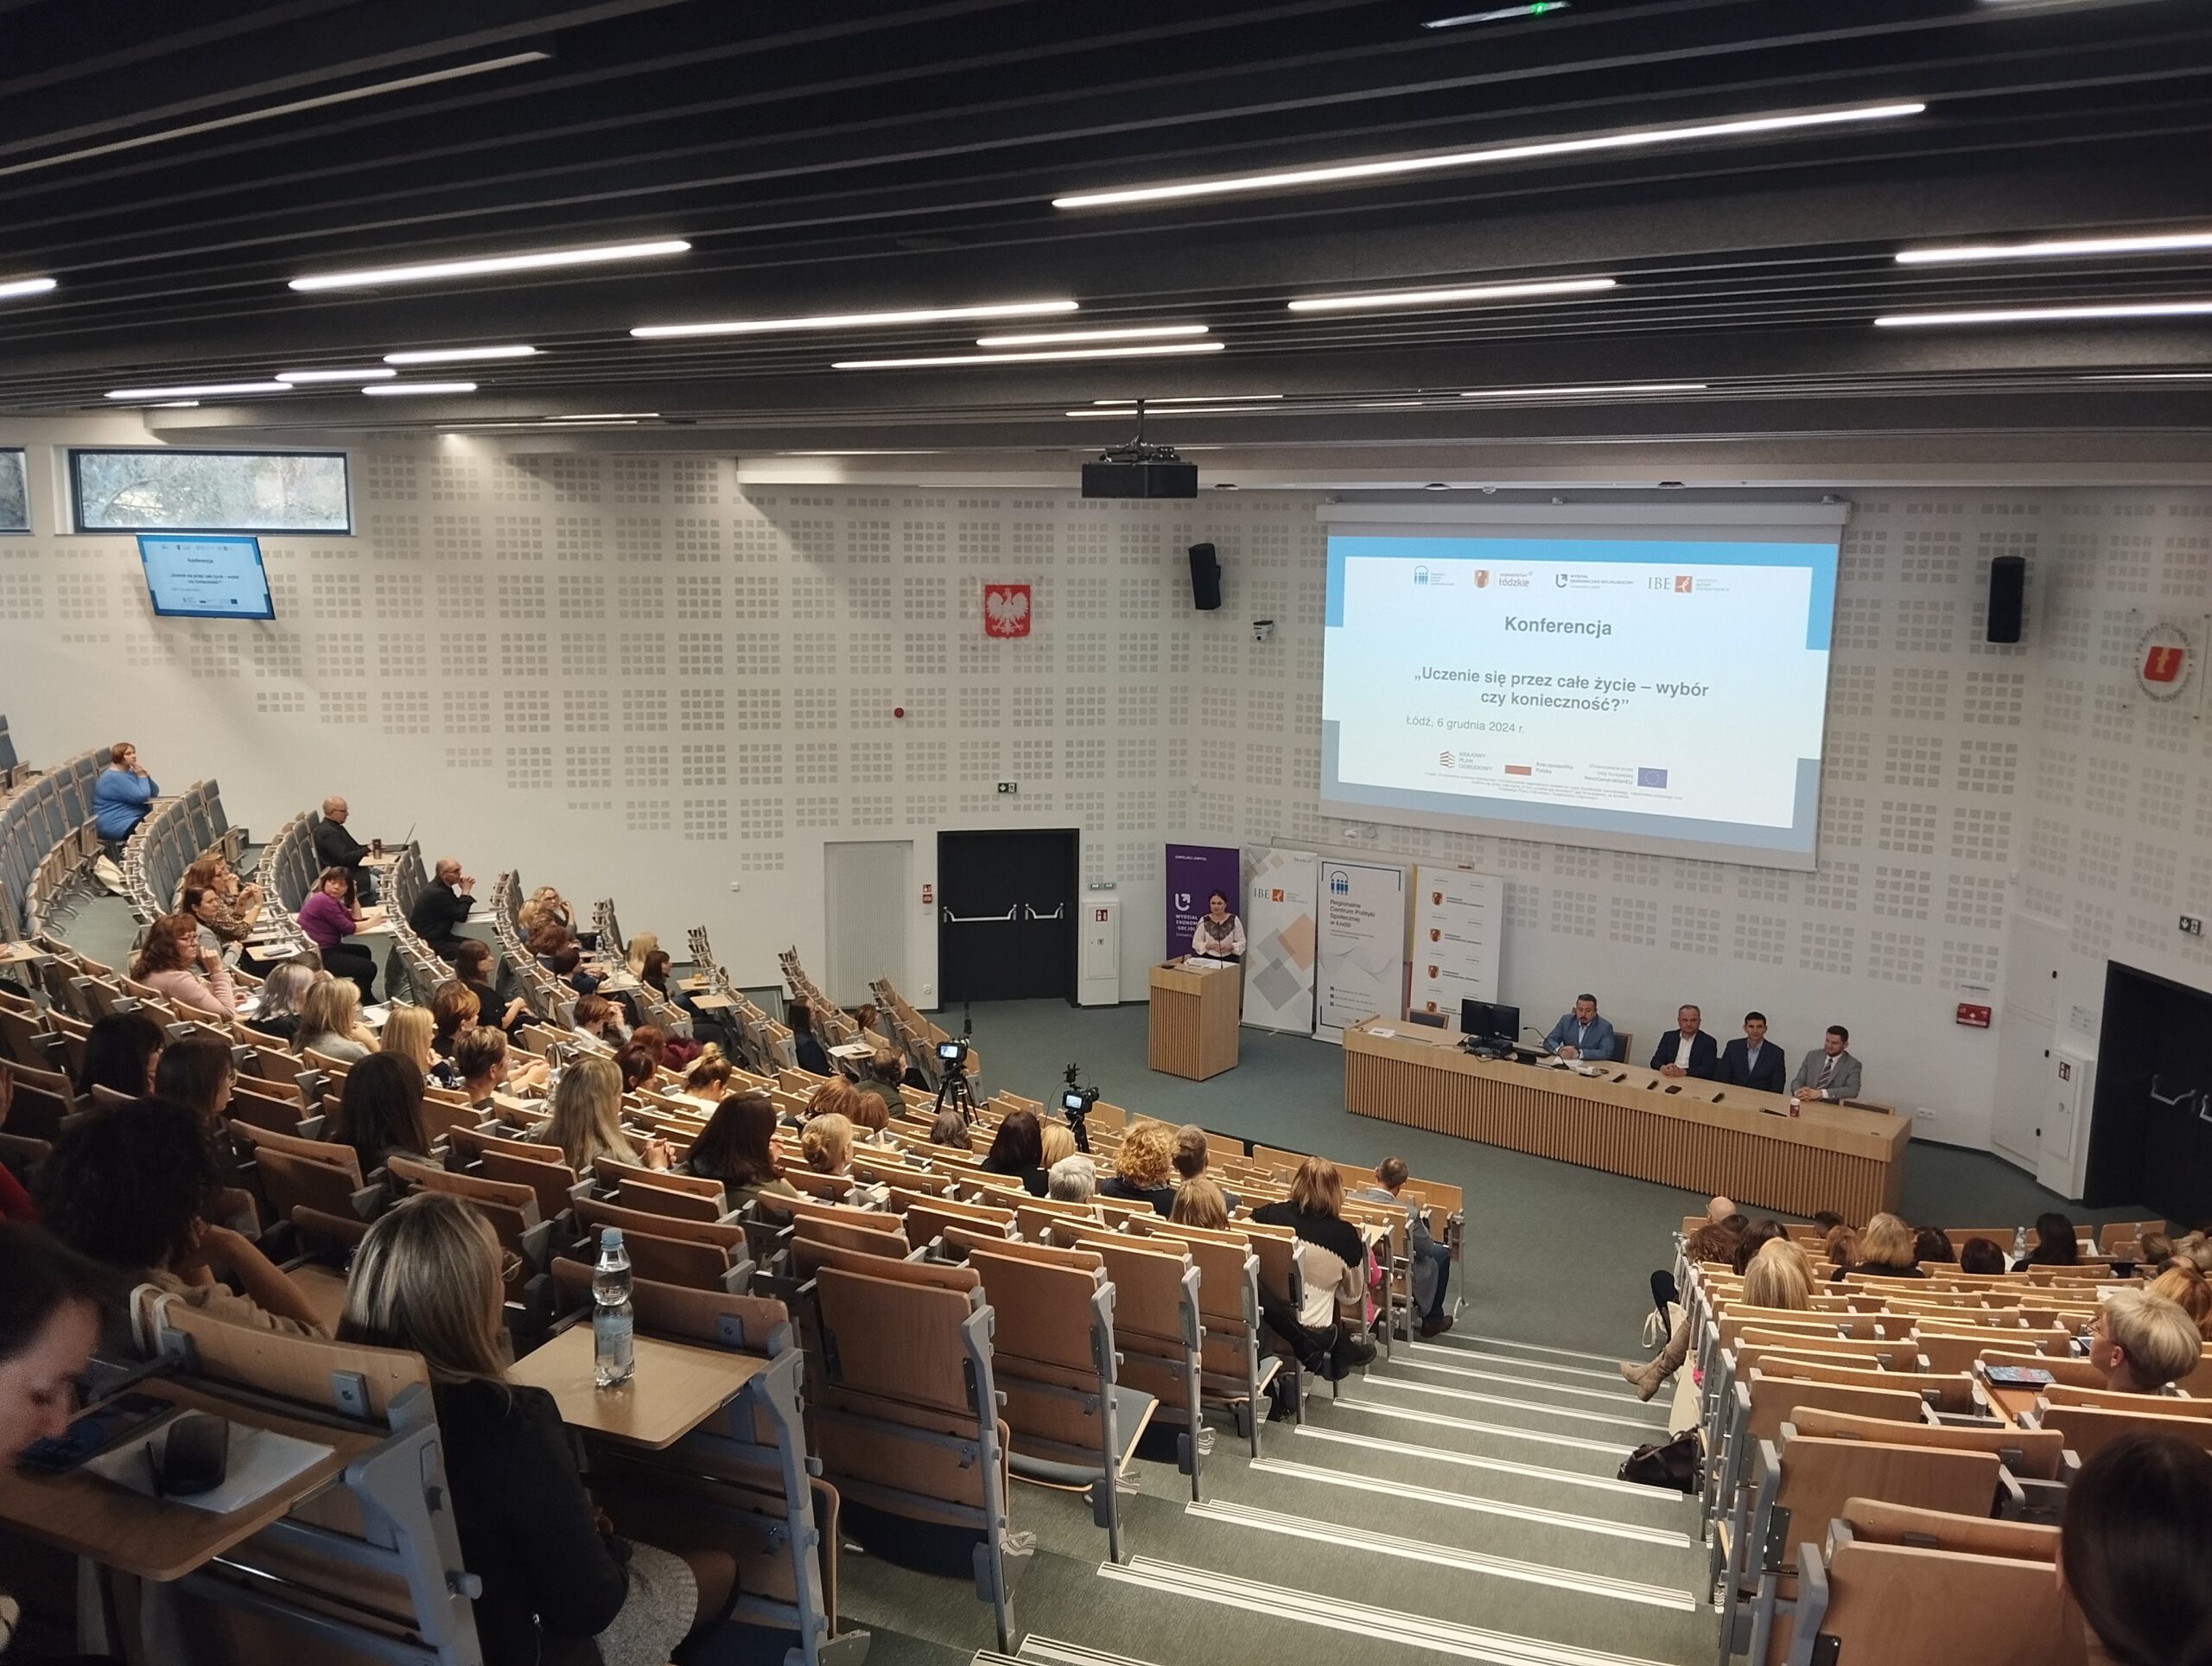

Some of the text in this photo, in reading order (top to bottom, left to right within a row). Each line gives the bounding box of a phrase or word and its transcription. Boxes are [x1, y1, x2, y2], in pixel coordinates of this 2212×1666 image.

[1499, 577, 1529, 588] łódzkie
[1648, 576, 1671, 590] IBE
[1504, 616, 1612, 639] Konferencja
[1414, 666, 1480, 684] „Uczenie
[1484, 671, 1507, 688] się
[1511, 675, 1553, 689] przez
[1557, 675, 1590, 690] całe
[1594, 677, 1637, 695] życie
[1656, 681, 1710, 698] wybór
[1480, 691, 1630, 713] czy konieczność?”
[1406, 715, 1525, 734] Łódź, 6 grudnia 2024 r.
[1254, 887, 1269, 900] IBE
